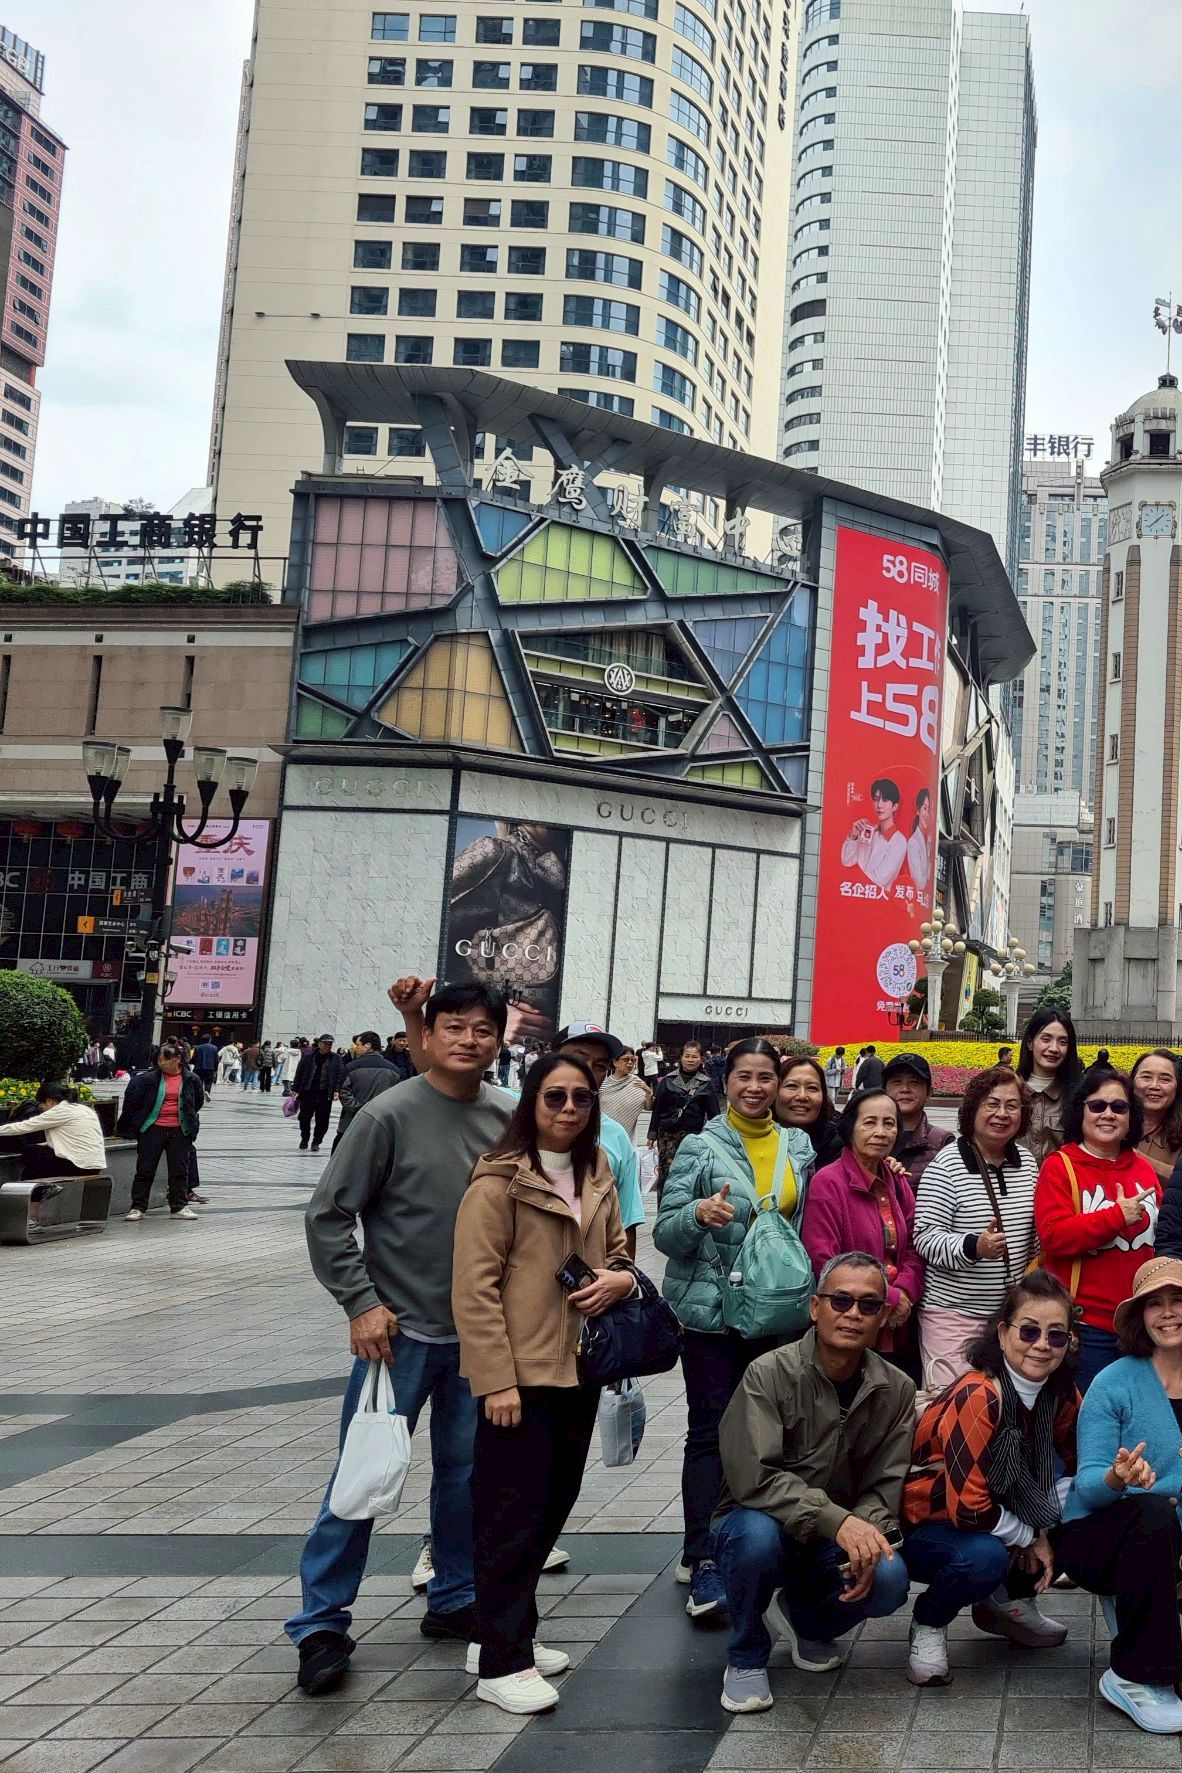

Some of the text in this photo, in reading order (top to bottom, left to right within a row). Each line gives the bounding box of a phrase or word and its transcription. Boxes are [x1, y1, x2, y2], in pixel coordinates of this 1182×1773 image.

[486, 447, 803, 557] 金鹰财富中心
[17, 511, 264, 550] 中国工商银行
[882, 554, 941, 594] 58同城
[850, 681, 940, 755] 上58
[314, 777, 424, 799] GUCCI
[596, 801, 689, 831] GUCCI
[840, 881, 889, 901] 名企招人
[455, 939, 552, 962] GUCCI
[173, 1010, 248, 1020] ICBC 工银信用卡
[705, 1004, 749, 1018] GUCCI
